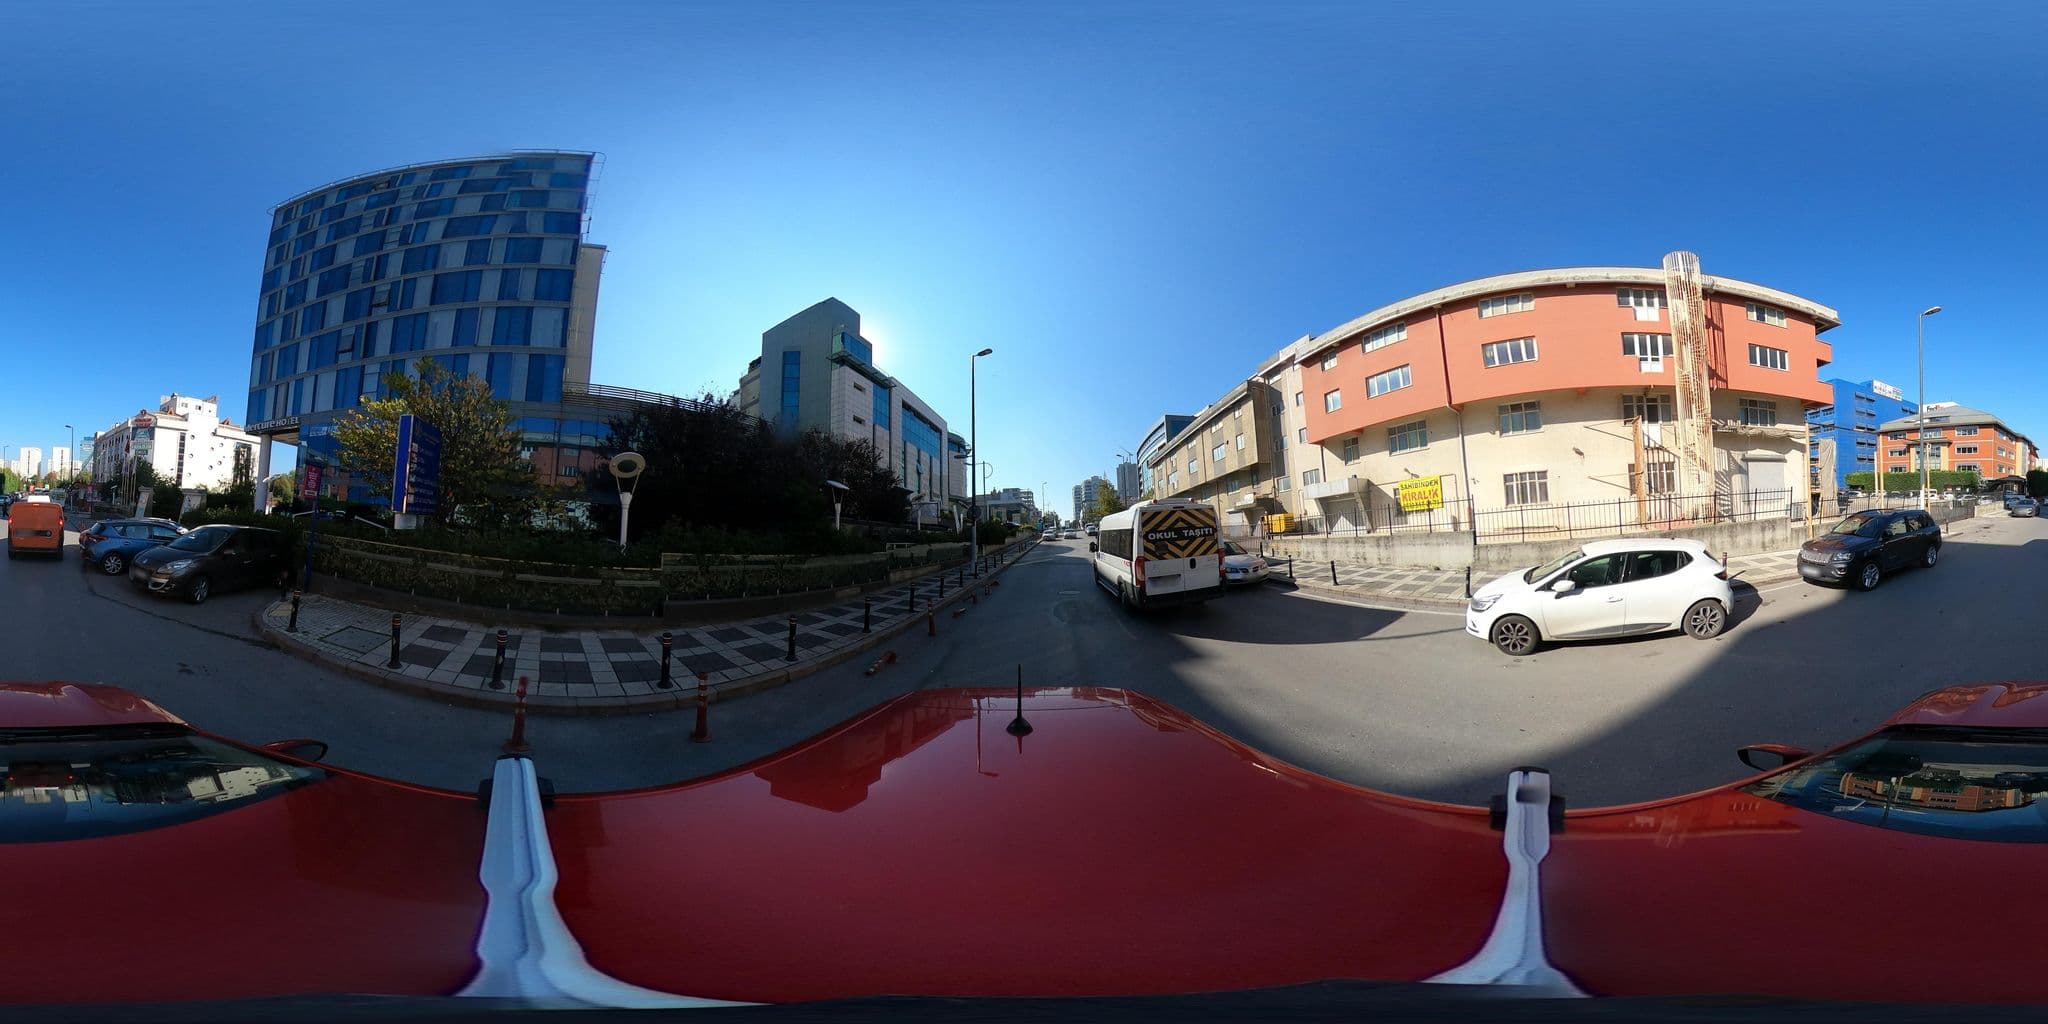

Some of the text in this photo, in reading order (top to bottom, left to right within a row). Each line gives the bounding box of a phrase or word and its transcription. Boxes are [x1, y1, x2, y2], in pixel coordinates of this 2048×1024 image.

[276, 416, 299, 427] HOTEL
[1148, 527, 1213, 540] OKUL TAŞITI
